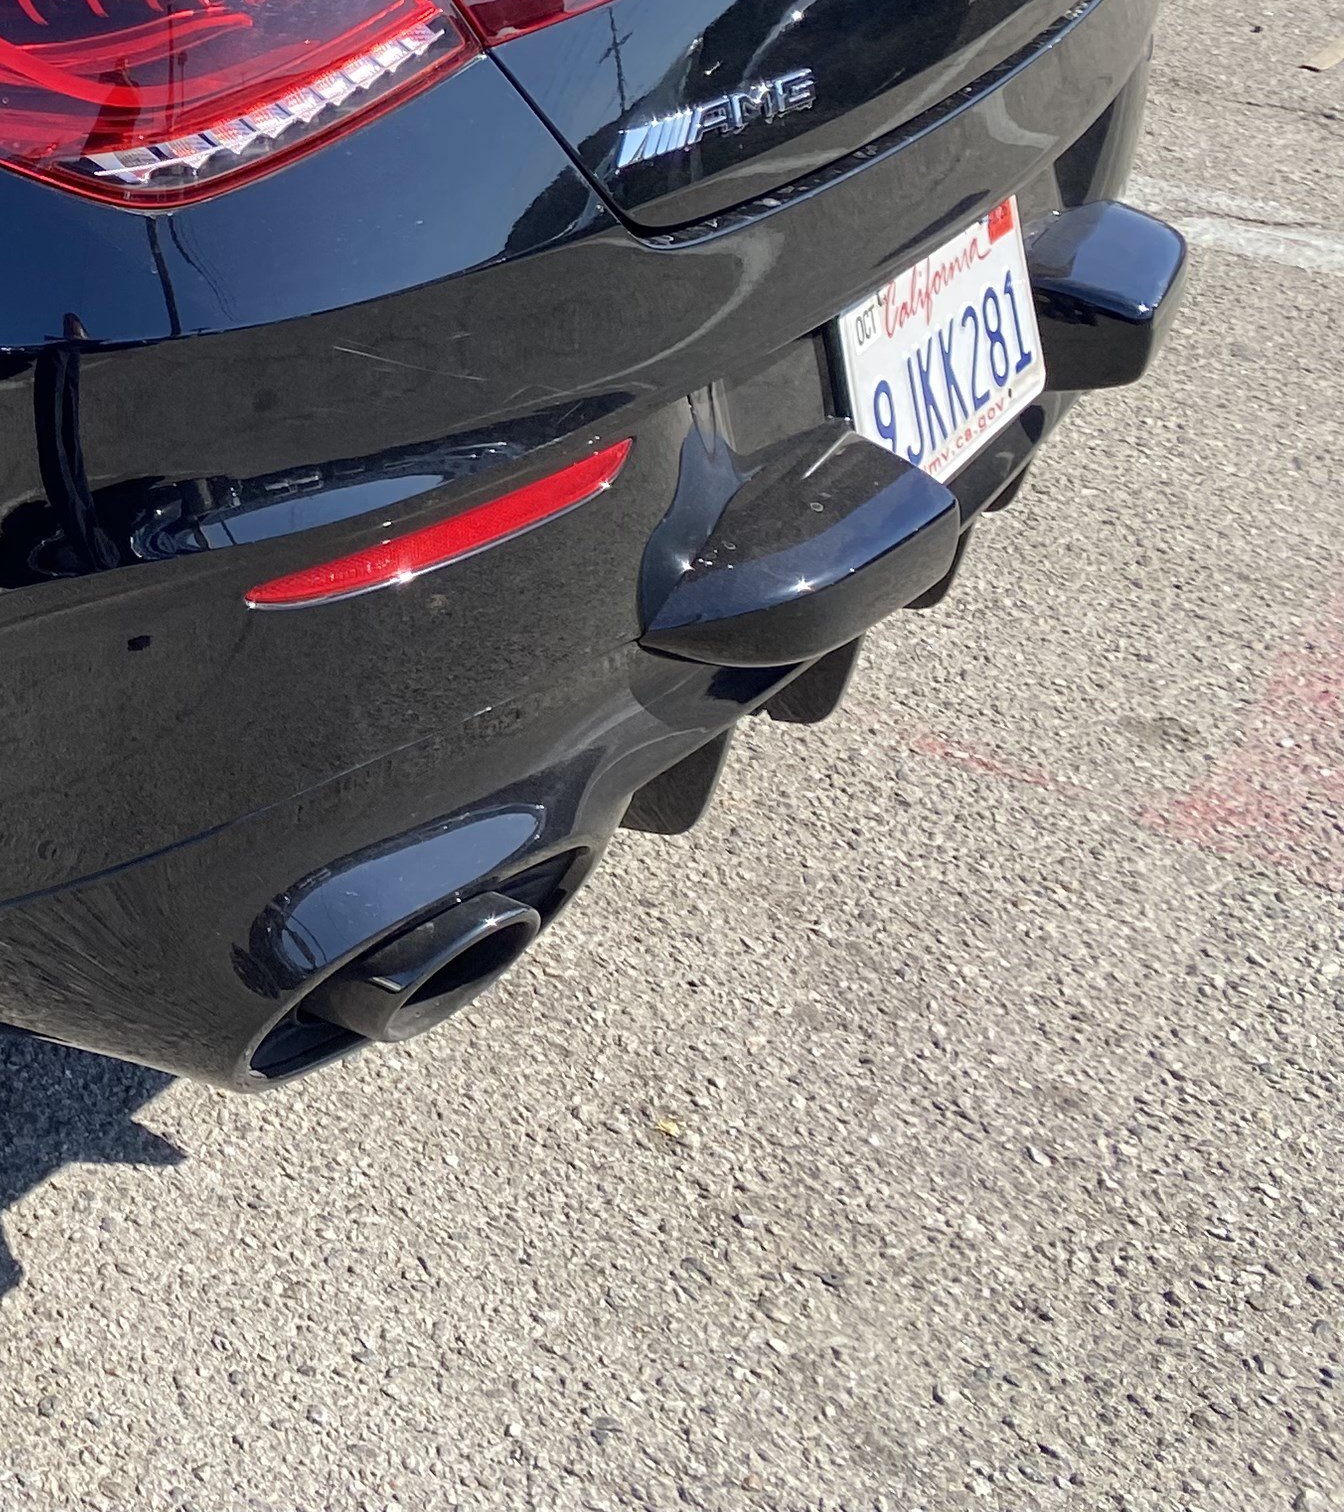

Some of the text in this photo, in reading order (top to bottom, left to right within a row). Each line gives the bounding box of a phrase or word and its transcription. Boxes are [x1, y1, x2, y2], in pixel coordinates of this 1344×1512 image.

[686, 68, 816, 146] AMG
[855, 304, 877, 347] OCT
[882, 236, 992, 339] California
[872, 269, 1032, 466] 9JKK281
[923, 396, 1005, 475] mv.ca.gov
